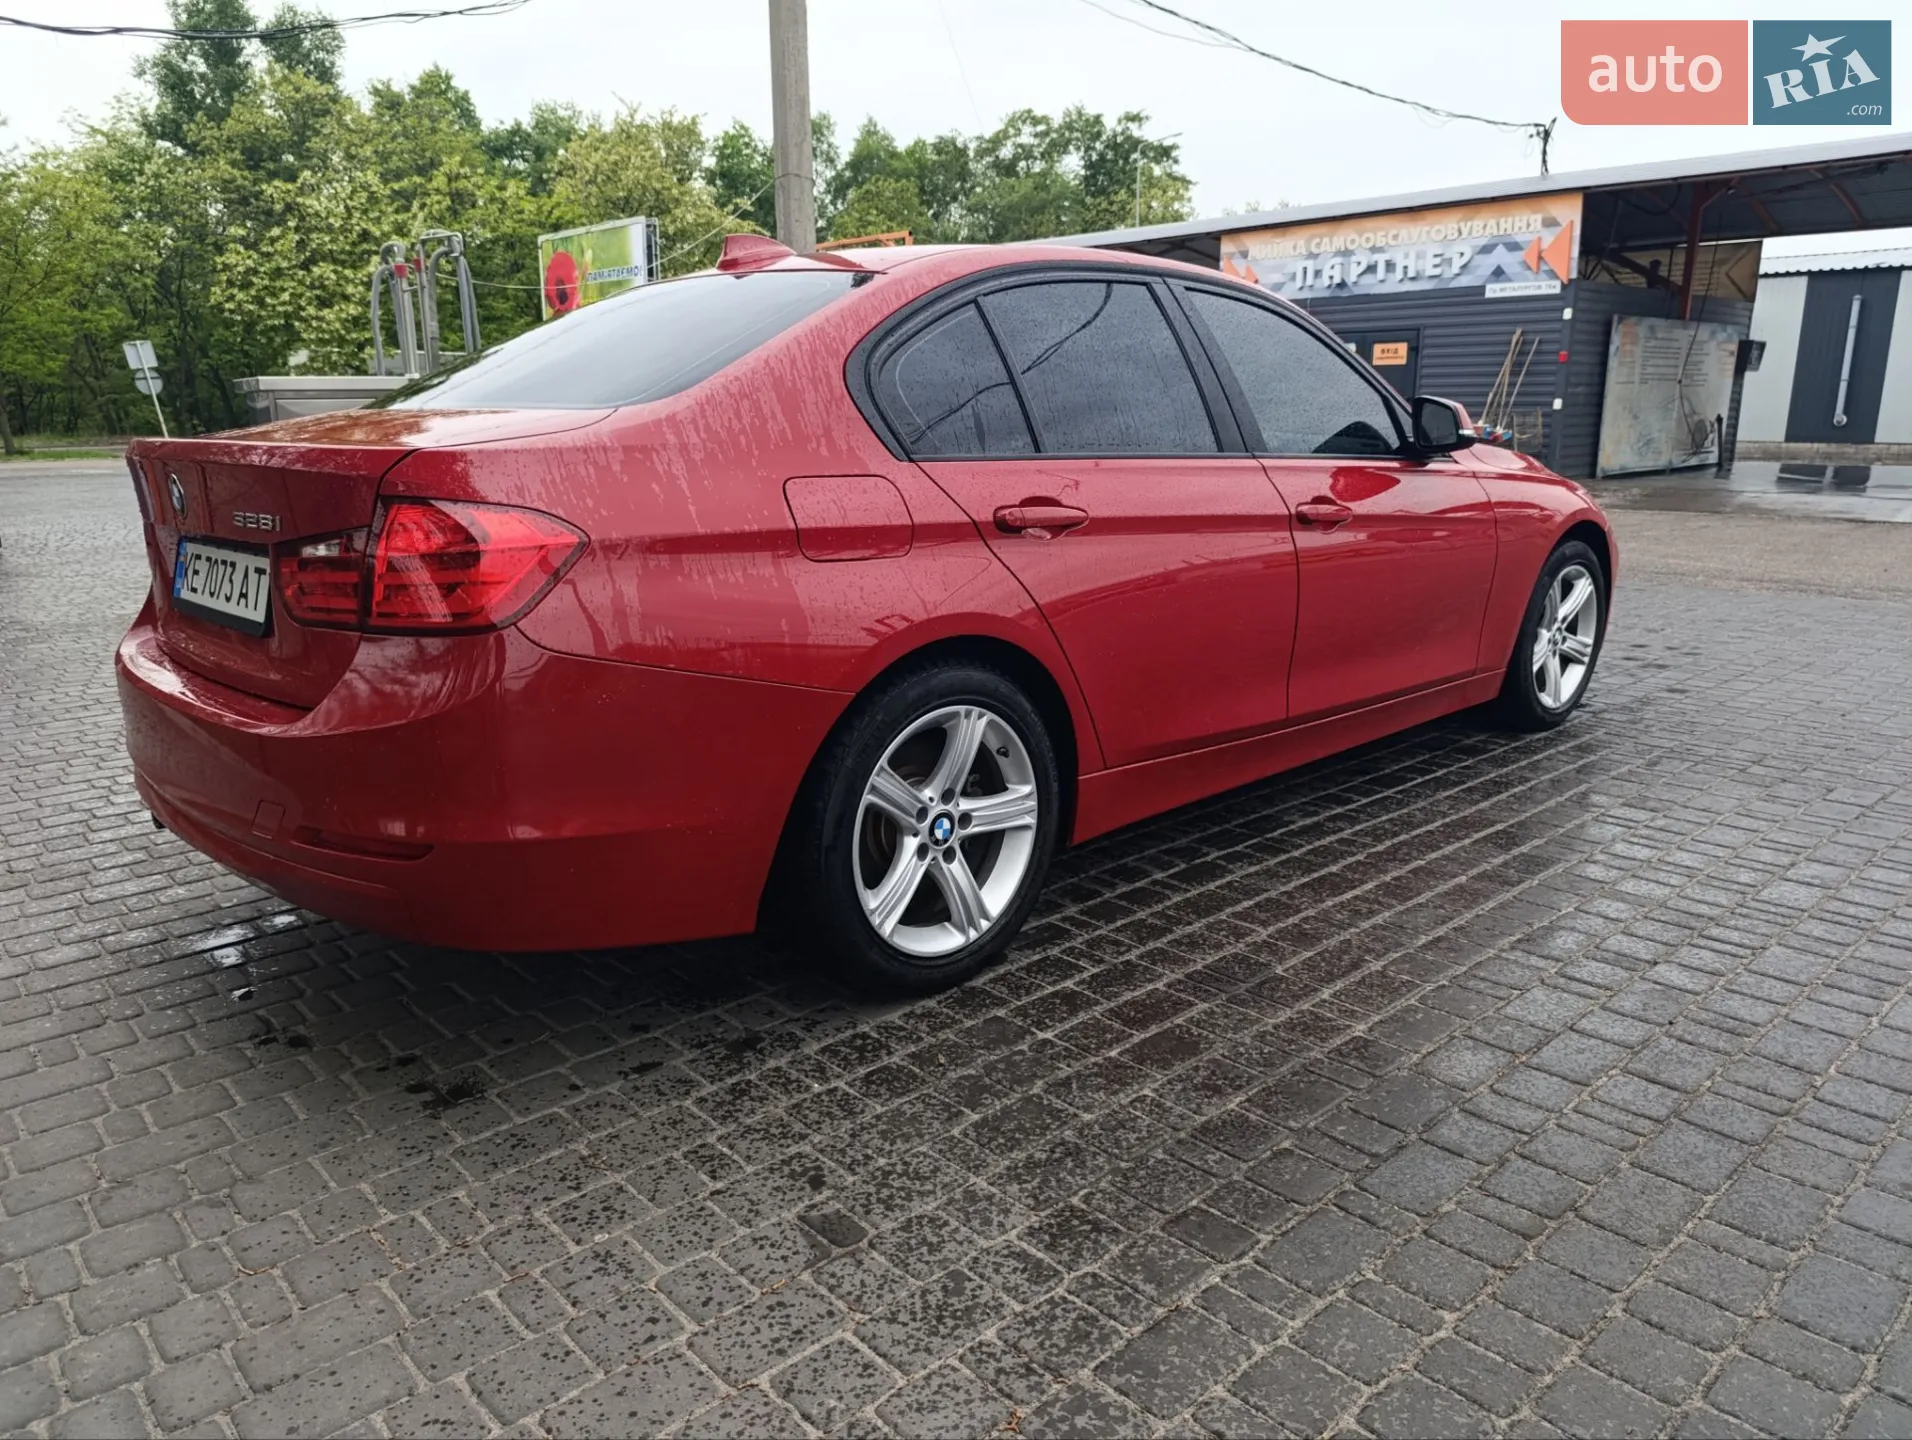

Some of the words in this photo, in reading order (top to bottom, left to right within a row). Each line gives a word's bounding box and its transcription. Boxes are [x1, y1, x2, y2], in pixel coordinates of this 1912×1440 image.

[1310, 213, 1542, 255] САМООБСЛУГОВУВАННЯ
[1295, 242, 1474, 291] ПАРТНЕР
[183, 552, 202, 594] KE
[201, 557, 237, 603] 7073
[236, 564, 267, 611] AT
